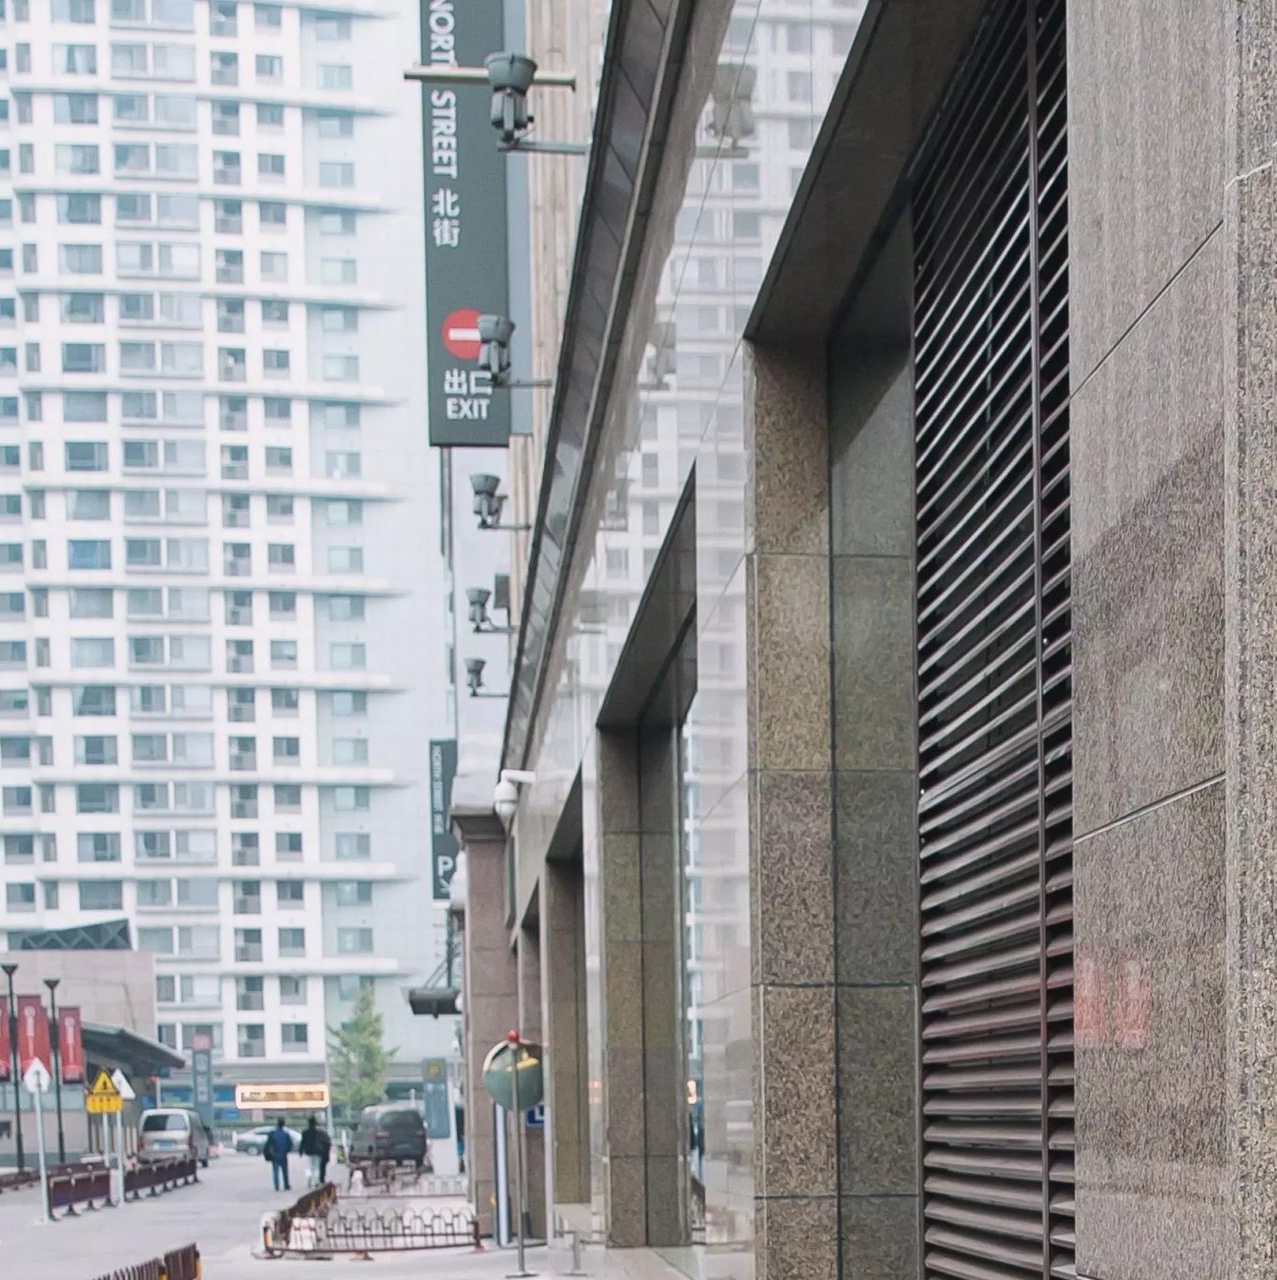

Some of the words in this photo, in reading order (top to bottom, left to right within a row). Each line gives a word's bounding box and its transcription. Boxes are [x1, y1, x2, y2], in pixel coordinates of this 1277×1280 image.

[429, 0, 457, 68] NORT
[431, 89, 457, 179] STREET
[432, 187, 460, 247] 北街
[444, 368, 492, 395] 出口
[447, 397, 490, 420] EXIT
[438, 856, 454, 877] P
